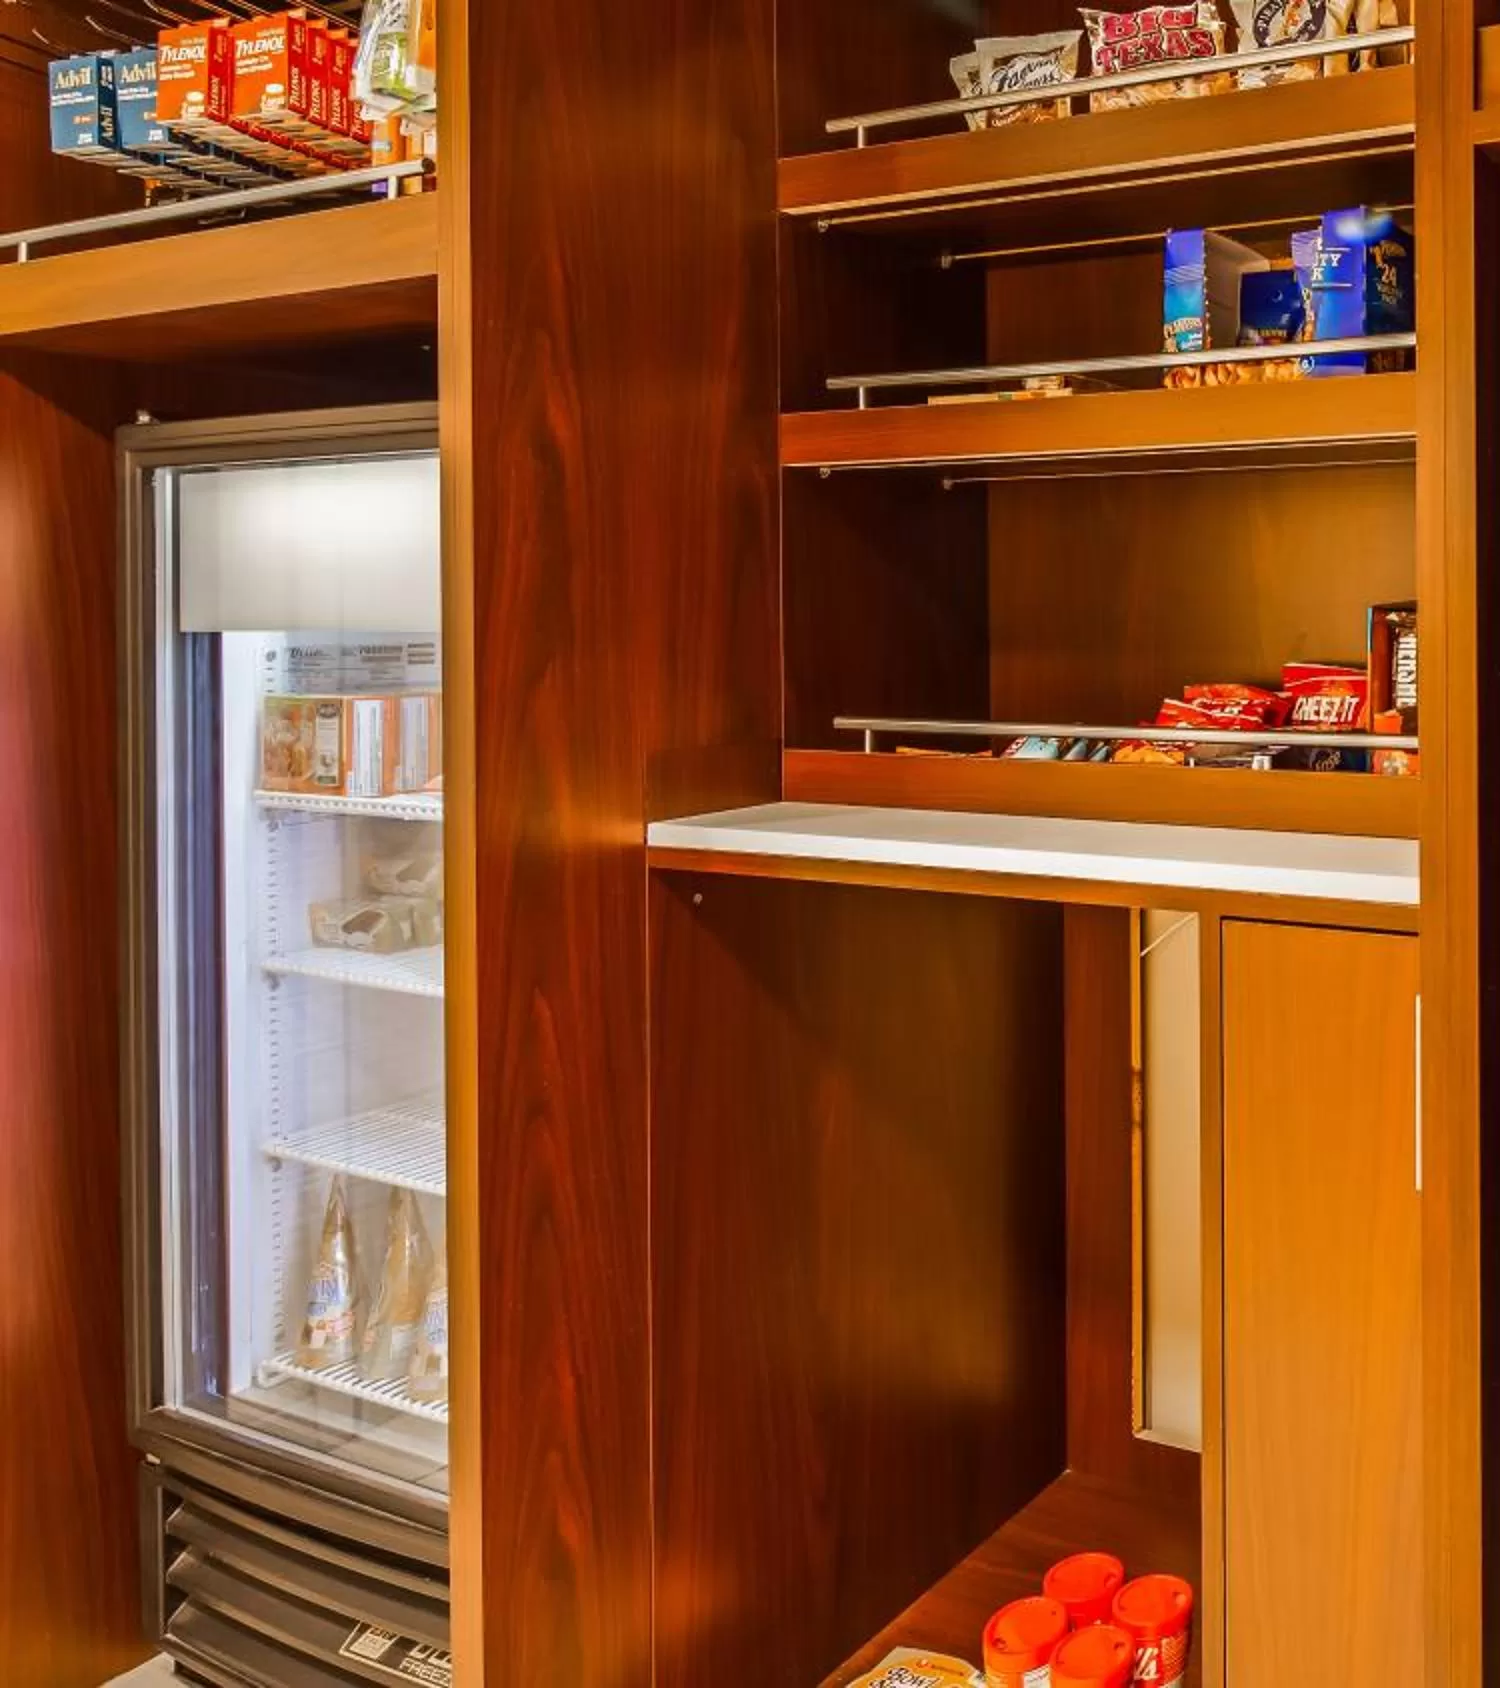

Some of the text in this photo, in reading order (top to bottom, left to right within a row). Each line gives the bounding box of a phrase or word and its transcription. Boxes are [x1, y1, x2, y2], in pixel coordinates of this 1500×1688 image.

[159, 45, 205, 65] TYLENOL
[235, 36, 285, 58] TYLENOL
[1096, 29, 1215, 73] TEXAS
[55, 66, 92, 89] Advil
[120, 61, 157, 83] Advil
